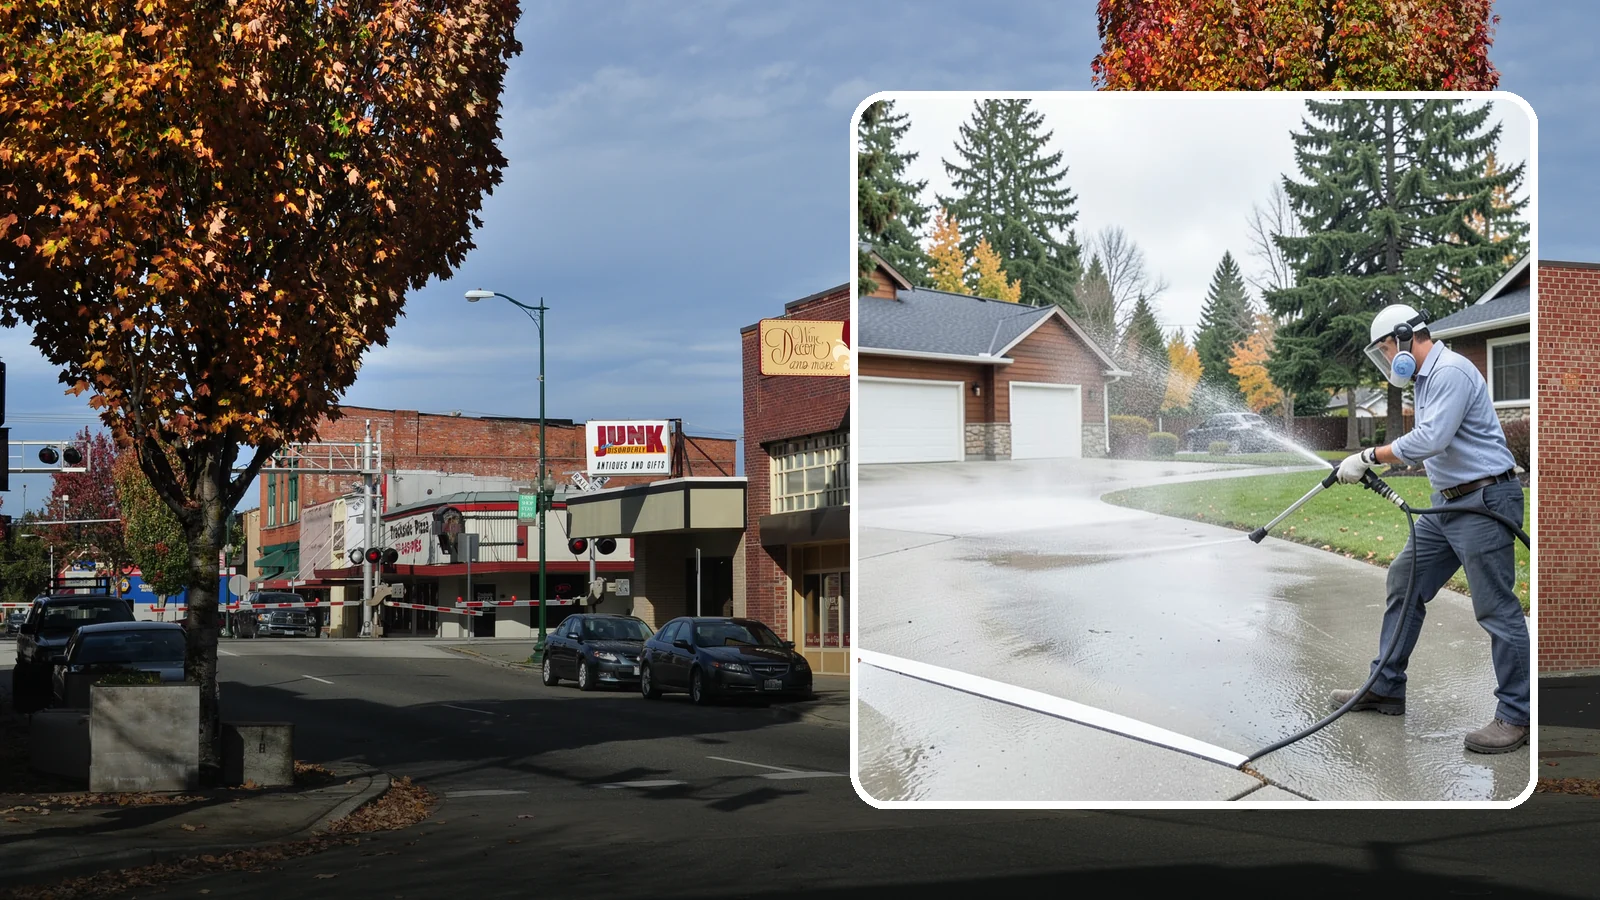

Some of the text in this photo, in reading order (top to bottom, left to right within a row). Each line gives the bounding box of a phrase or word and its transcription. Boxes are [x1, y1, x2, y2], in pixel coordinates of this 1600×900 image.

[765, 328, 831, 365] Decor
[811, 361, 835, 370] MORE
[595, 425, 665, 457] JUNK
[597, 460, 665, 470] ANTIQUES AND GIFTS
[390, 519, 429, 539] Trackside Pizza
